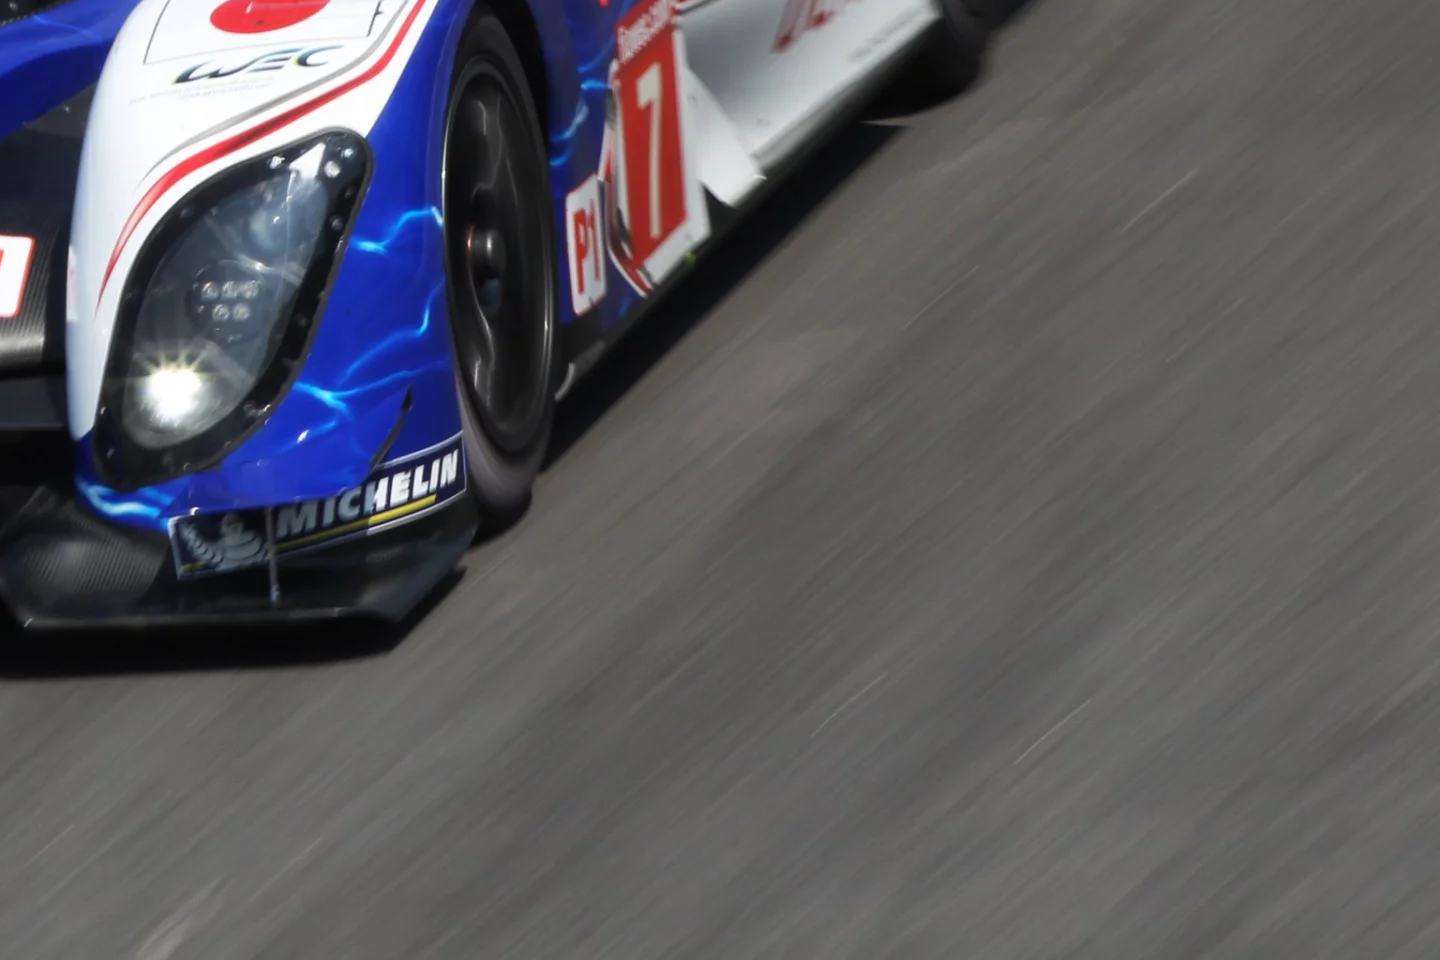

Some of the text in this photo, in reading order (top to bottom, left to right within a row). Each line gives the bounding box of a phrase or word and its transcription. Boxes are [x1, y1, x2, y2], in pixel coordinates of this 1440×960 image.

[171, 44, 345, 85] WEC
[637, 62, 662, 239] 7
[572, 198, 602, 296] P1
[275, 448, 459, 539] MICHELIN
